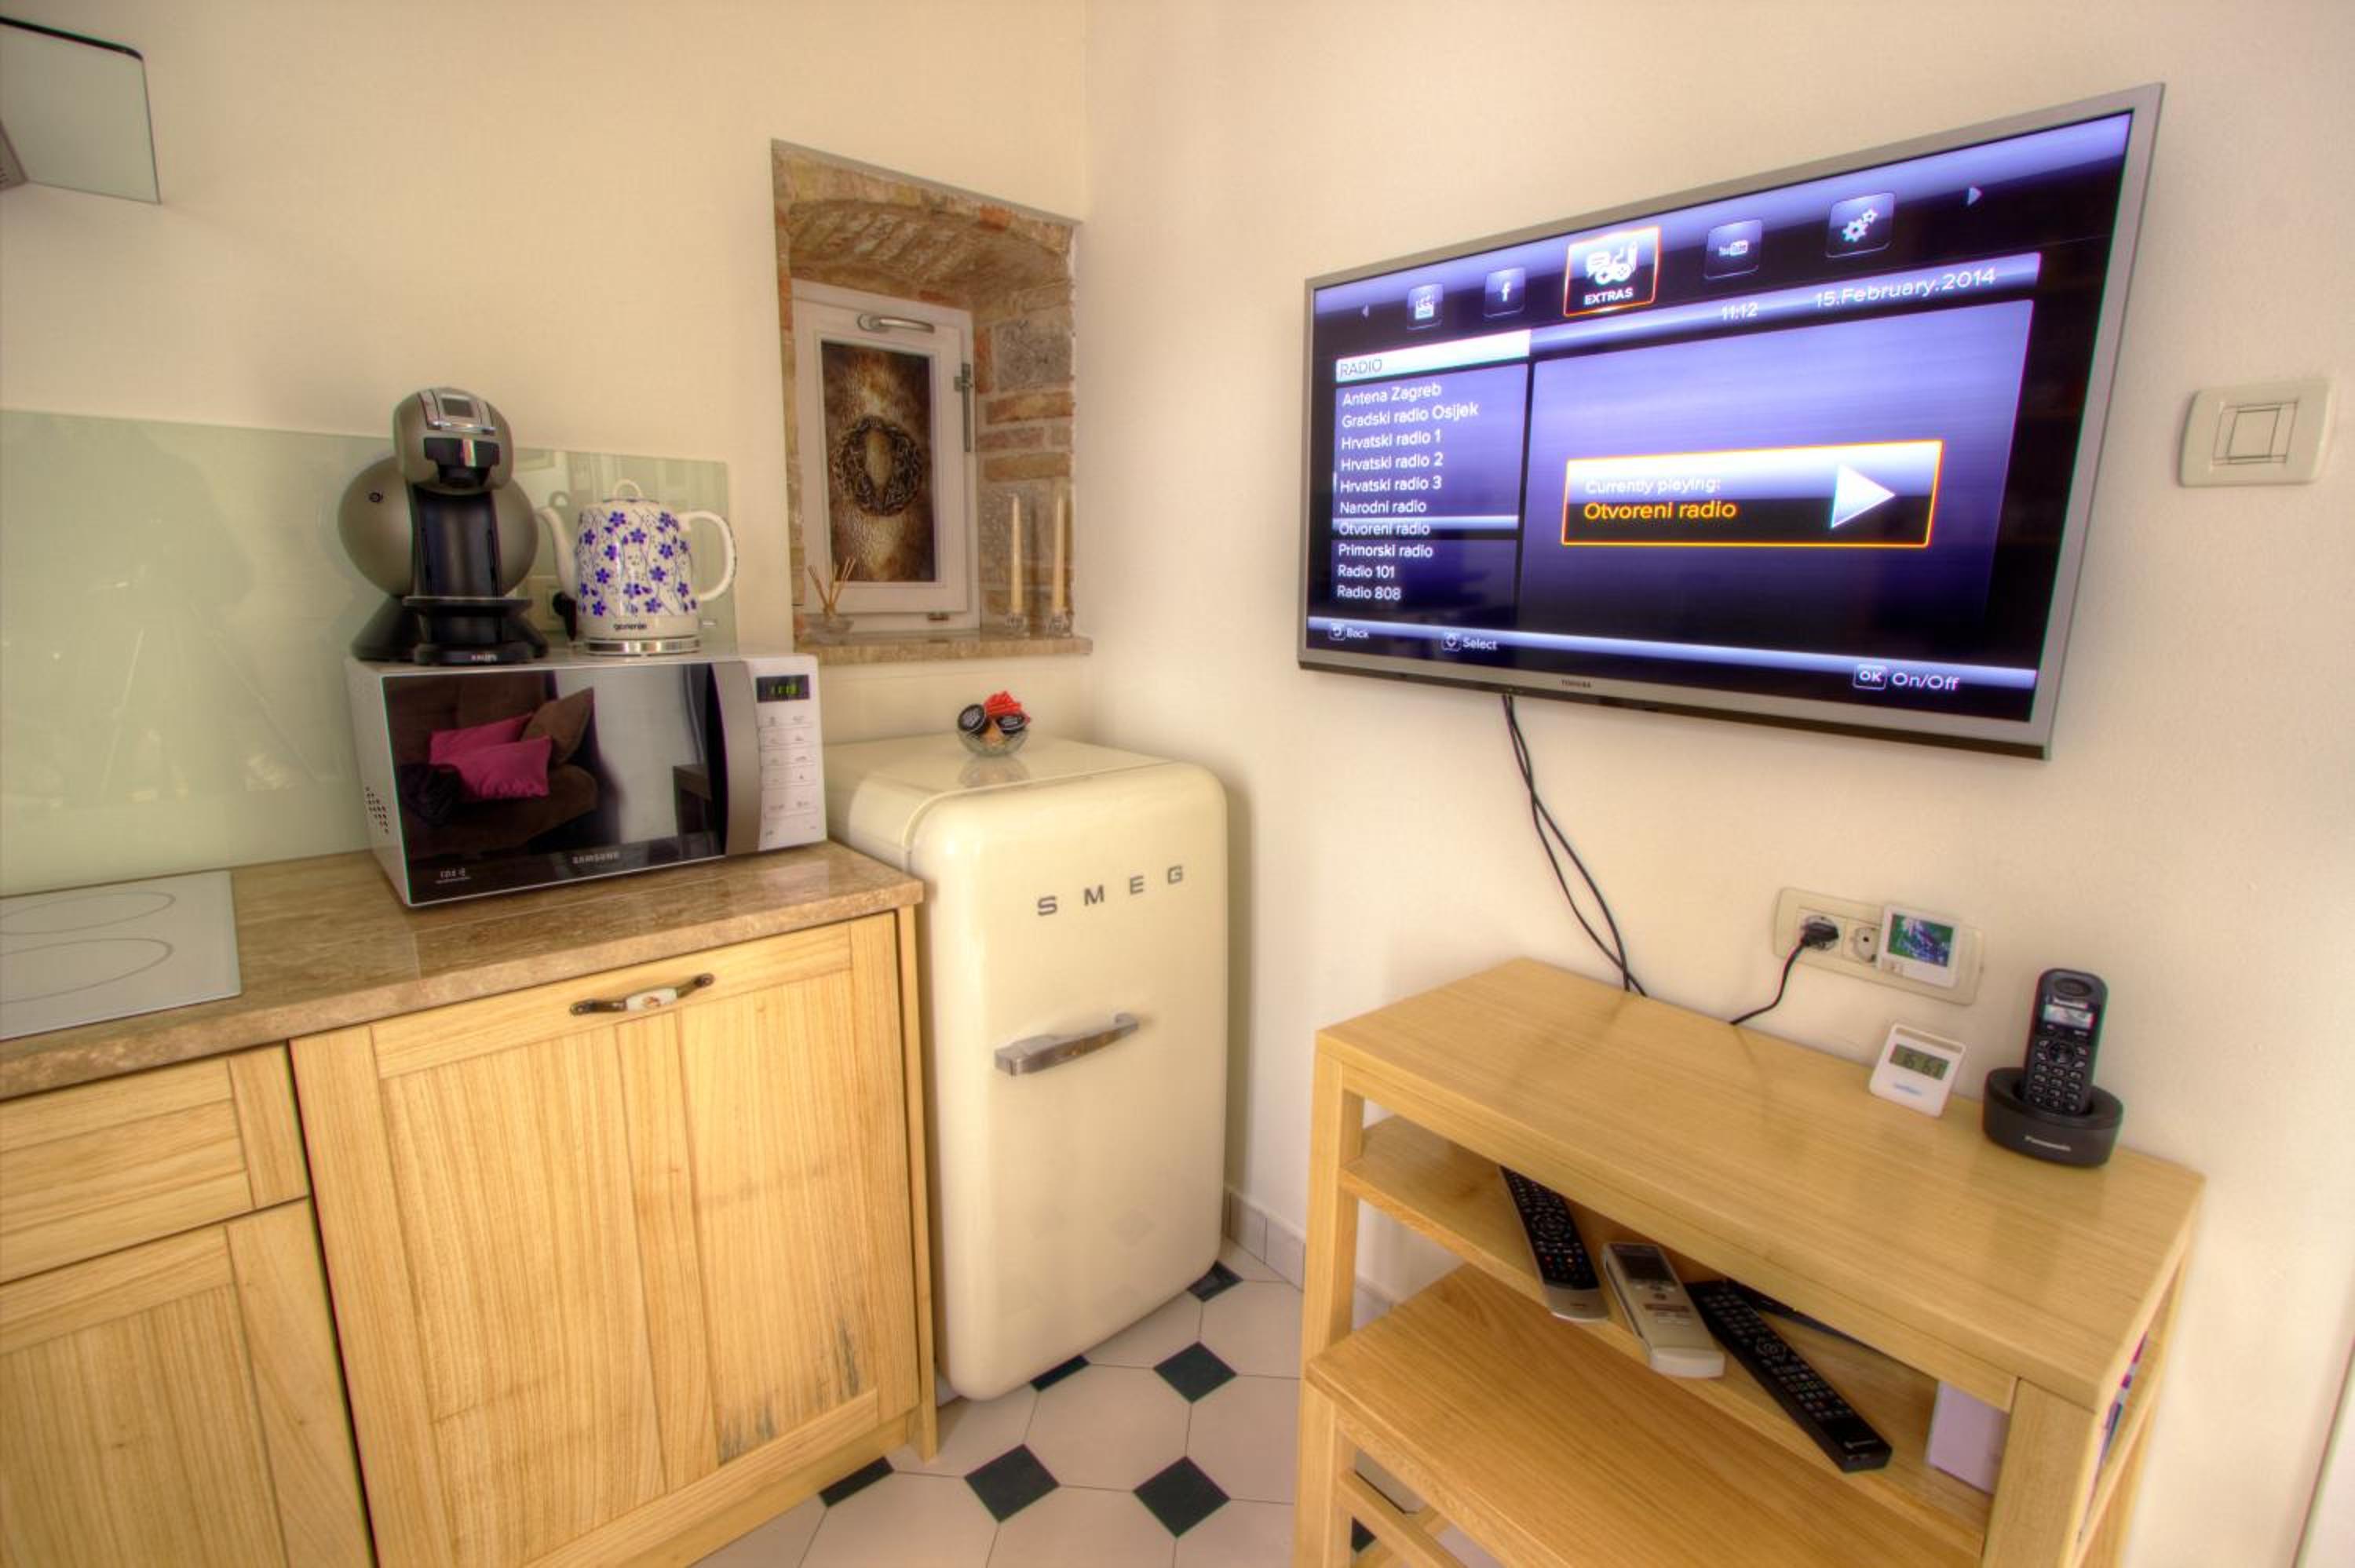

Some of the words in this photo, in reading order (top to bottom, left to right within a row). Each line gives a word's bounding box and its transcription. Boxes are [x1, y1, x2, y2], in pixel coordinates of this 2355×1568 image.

[1583, 287, 1634, 305] EXTRAS
[1722, 302, 1758, 320] 11:12
[1339, 359, 1382, 377] RADIO
[1342, 388, 1387, 406] Antena
[1391, 383, 1441, 403] Zagreb
[1342, 411, 1390, 428] Gradski
[1393, 407, 1429, 422] radio
[1432, 402, 1479, 421] Osijek
[1341, 434, 1392, 450] Hrvatski
[1396, 430, 1430, 445] radio
[1434, 429, 1441, 443] 1
[1341, 454, 1392, 471] Hrvatski
[1396, 454, 1429, 469] radio
[1434, 454, 1444, 467] 2
[1340, 477, 1391, 494] Hrvatski
[1395, 476, 1429, 490] radio
[1433, 476, 1442, 490] 3
[1339, 500, 1389, 514] Narodni
[1393, 499, 1426, 513] radio
[1583, 501, 1673, 520] Otvoreni
[1679, 499, 1737, 519] radio
[1338, 522, 1393, 536] Otvoreni
[1396, 522, 1430, 536] radio
[1338, 544, 1395, 557] Primorski
[1398, 544, 1433, 558] radio
[1338, 564, 1373, 578] Radio
[1376, 566, 1395, 578] 101
[1337, 585, 1372, 600] Radio
[1375, 587, 1401, 600] 808
[1462, 637, 1498, 651] Select
[1859, 669, 1882, 684] OK
[1891, 671, 1960, 691] On/Off
[1037, 865, 1184, 917] SMEG
